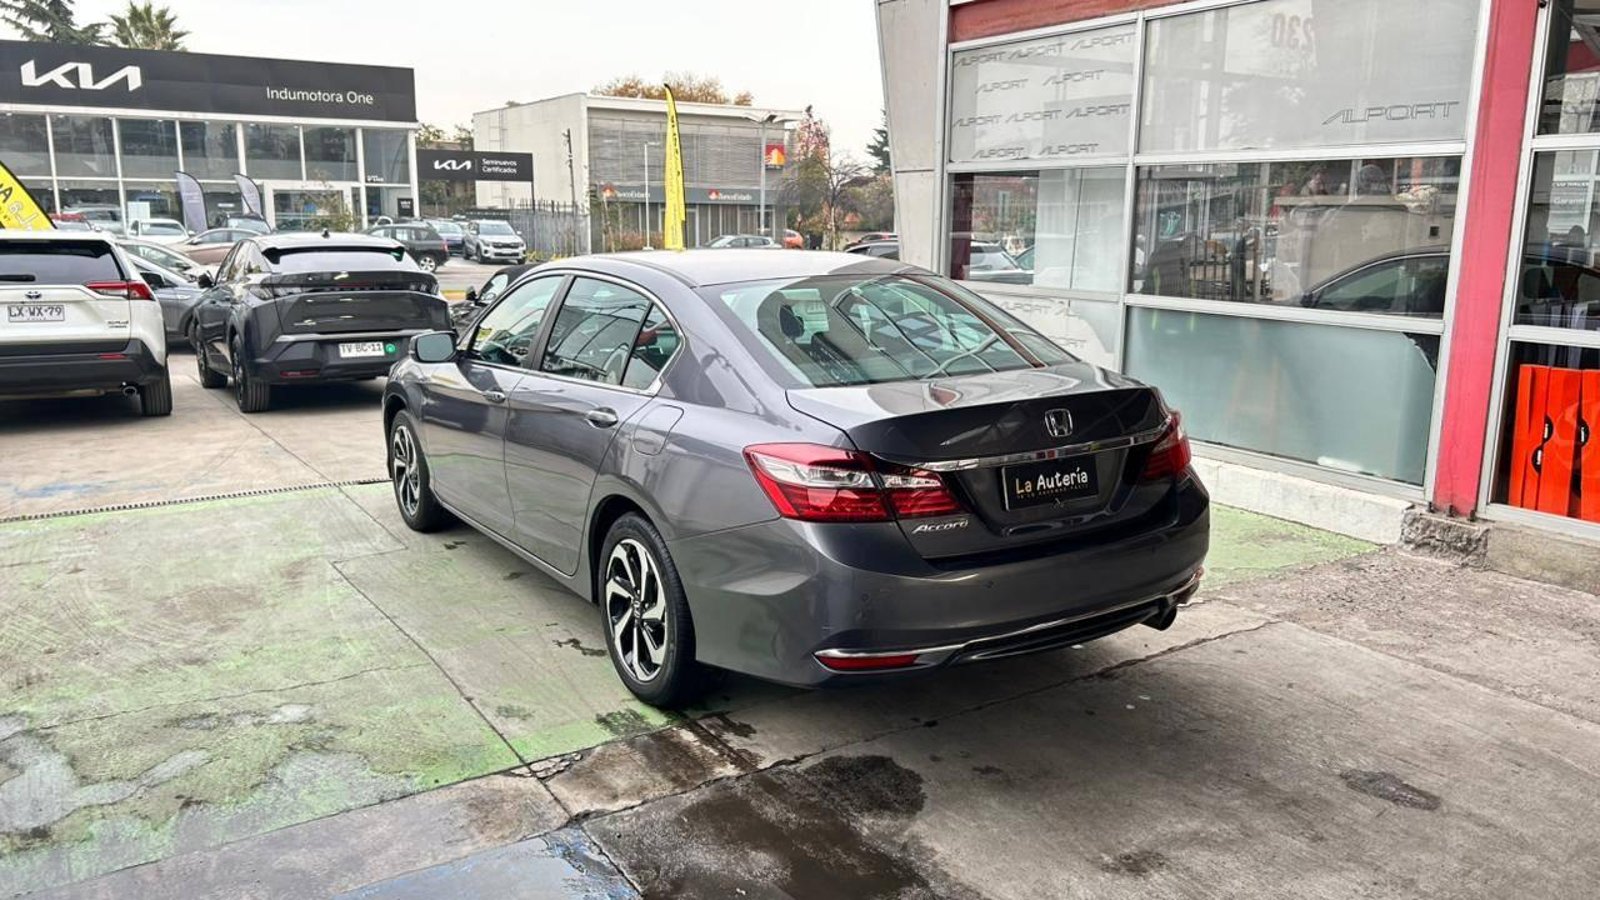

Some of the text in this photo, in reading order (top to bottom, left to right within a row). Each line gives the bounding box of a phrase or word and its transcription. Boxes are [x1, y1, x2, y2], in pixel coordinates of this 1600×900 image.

[954, 31, 1136, 68] ALPORT ALPORT ALPORT
[20, 60, 142, 91] KIA
[975, 70, 1104, 94] ALPORT ALPORT
[266, 86, 374, 105] Indumotora One
[953, 103, 1131, 128] ALPORT ALPORT ALPORT
[1322, 101, 1460, 125] ALPORT
[1039, 143, 1099, 156] ALPORT
[434, 160, 472, 170] KIA
[482, 158, 517, 167] Seminuevos
[482, 166, 517, 174] Certificados
[1015, 477, 1032, 494] La
[1036, 466, 1089, 491] Autería
[911, 519, 969, 534] Accord
